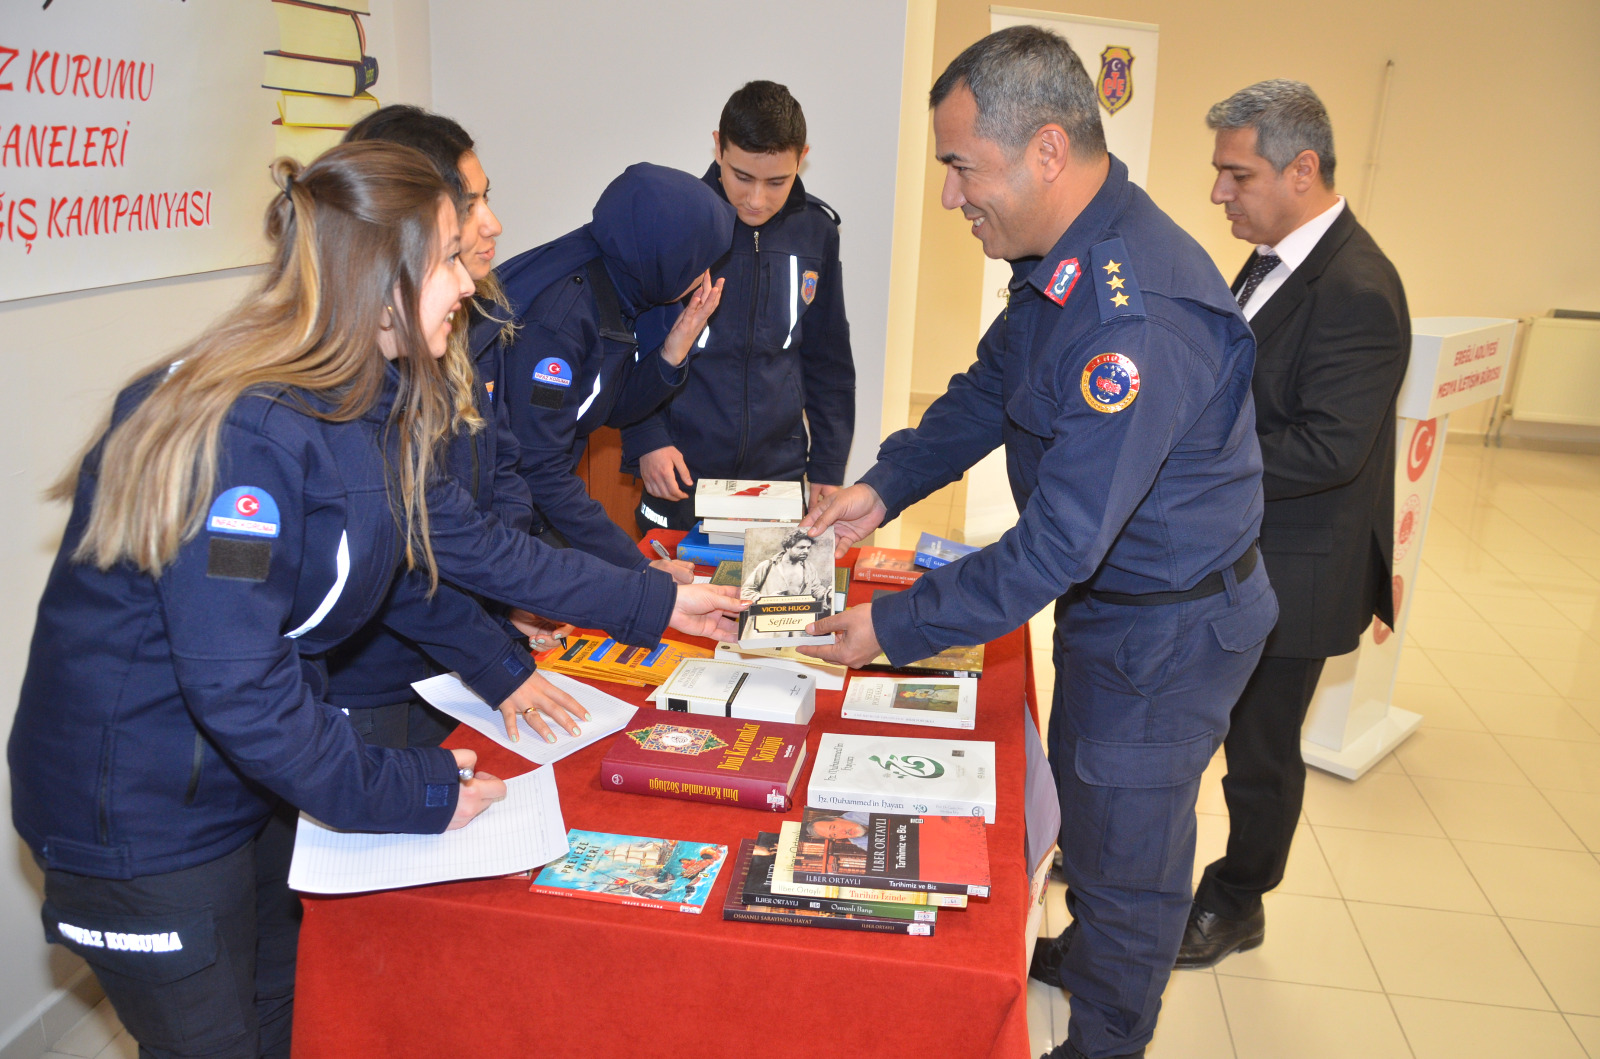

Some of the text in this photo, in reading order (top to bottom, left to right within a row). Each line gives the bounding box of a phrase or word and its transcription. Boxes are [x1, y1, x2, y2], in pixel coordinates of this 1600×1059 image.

[26, 49, 154, 101] KURUMU
[0, 121, 130, 168] ANELERİ
[0, 191, 211, 254] IŞ KAMPANYASI
[788, 604, 811, 612] HUGO
[768, 617, 803, 627] Sefiller
[724, 722, 761, 757] Kavramlar
[751, 736, 785, 762] Sözlüğü
[717, 755, 745, 771] Dini
[649, 777, 739, 802] Dini Kavramlar Sözlüğü
[561, 841, 589, 874] PREVEZE
[871, 818, 887, 872] İLBER ORTAYLI
[895, 824, 907, 869] Tarihimiz ve Biz
[576, 845, 601, 872] ZAFERİ
[806, 874, 827, 883] İLBER
[828, 877, 861, 886] ORTAYLI
[889, 880, 917, 889] Tarihimiz
[773, 898, 799, 907] ORTAYLI
[831, 903, 856, 912] Osmanlı
[849, 889, 879, 900] Tarihin
[880, 891, 908, 902] İzinde
[733, 913, 760, 921] OSMANLI
[760, 915, 793, 924] SARAYINDA
